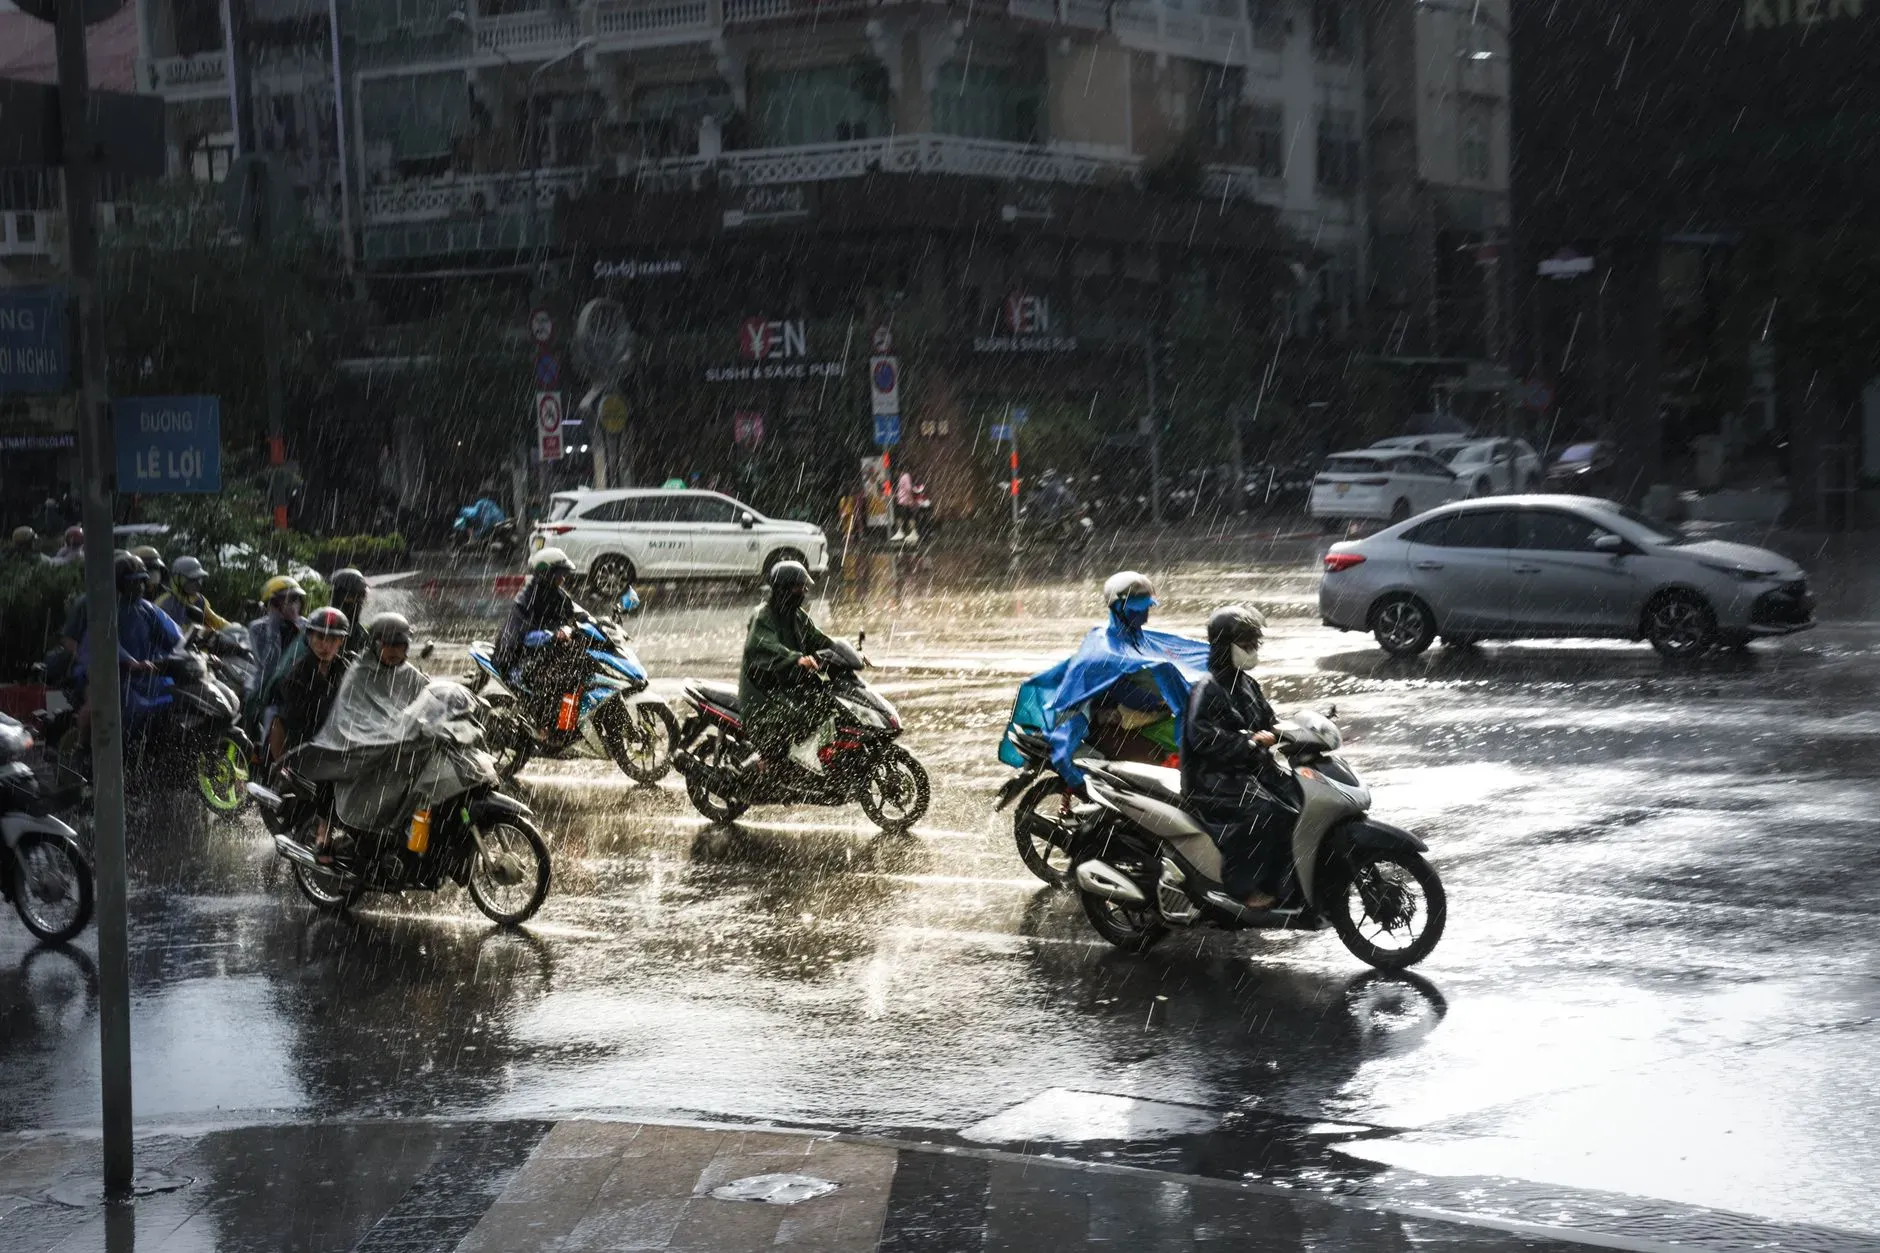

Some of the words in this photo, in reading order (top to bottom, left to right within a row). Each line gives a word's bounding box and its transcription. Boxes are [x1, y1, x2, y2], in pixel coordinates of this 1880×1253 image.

[705, 366, 750, 382] SUSHI
[763, 364, 806, 379] SAKE
[809, 362, 842, 377] PUB
[136, 444, 162, 478] LÊ
[168, 444, 202, 489] LỢI
